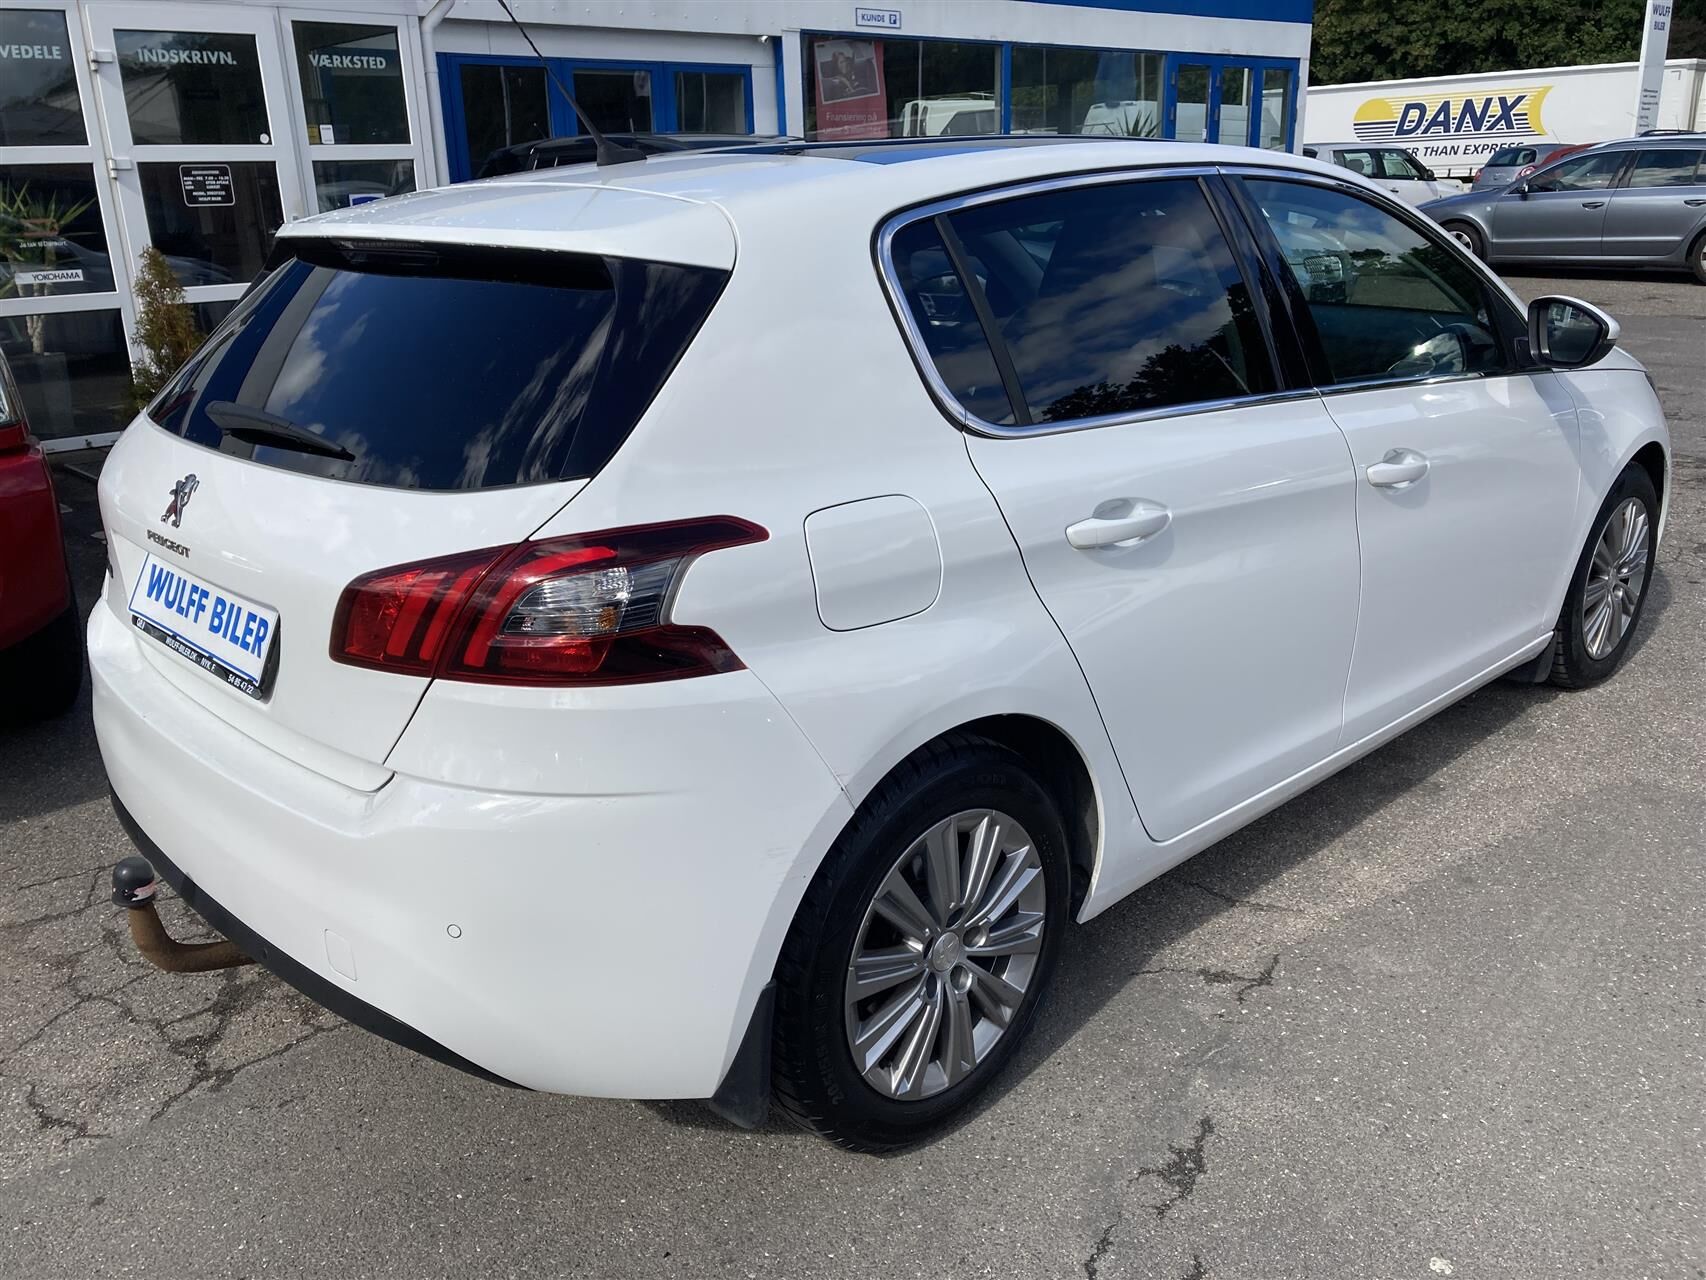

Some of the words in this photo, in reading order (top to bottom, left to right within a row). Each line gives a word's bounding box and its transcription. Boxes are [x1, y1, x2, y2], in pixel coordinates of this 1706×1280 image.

[861, 13, 885, 23] KUNDE
[137, 48, 237, 65] INDSKRIVN.
[308, 54, 387, 69] VÆRKSTED
[1394, 94, 1528, 137] DANX
[1423, 144, 1460, 157] THAN
[32, 271, 81, 281] YOKOHAMA
[146, 529, 191, 558] PEUGEOT
[146, 563, 210, 624] WULFF
[208, 595, 269, 659] BILER
